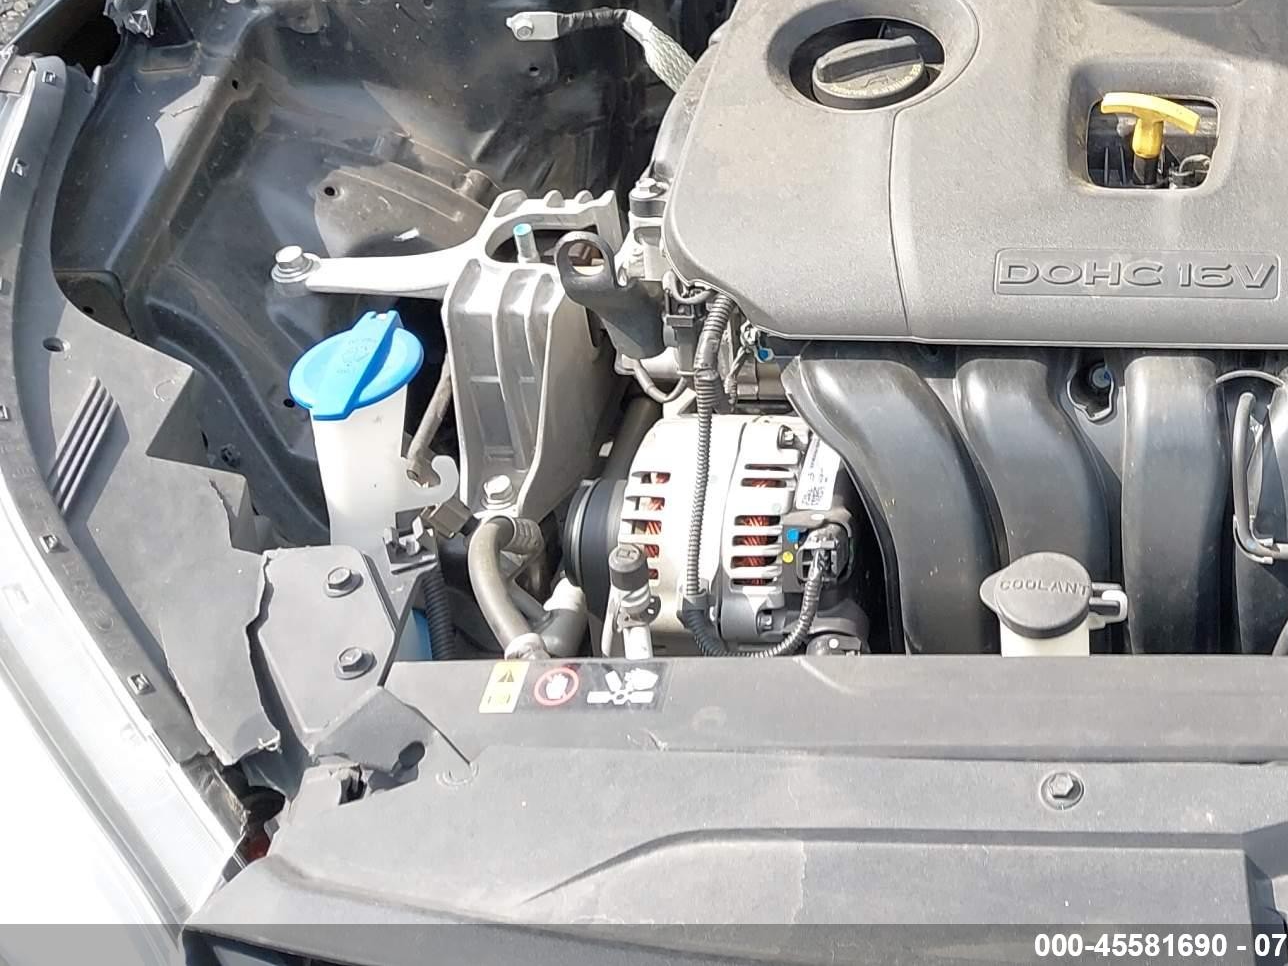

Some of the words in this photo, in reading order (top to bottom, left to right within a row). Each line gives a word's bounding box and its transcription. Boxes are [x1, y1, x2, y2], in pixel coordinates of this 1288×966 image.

[1000, 260, 1163, 287] DOHC
[1177, 262, 1276, 289] 16V
[1000, 578, 1090, 596] COOLANT
